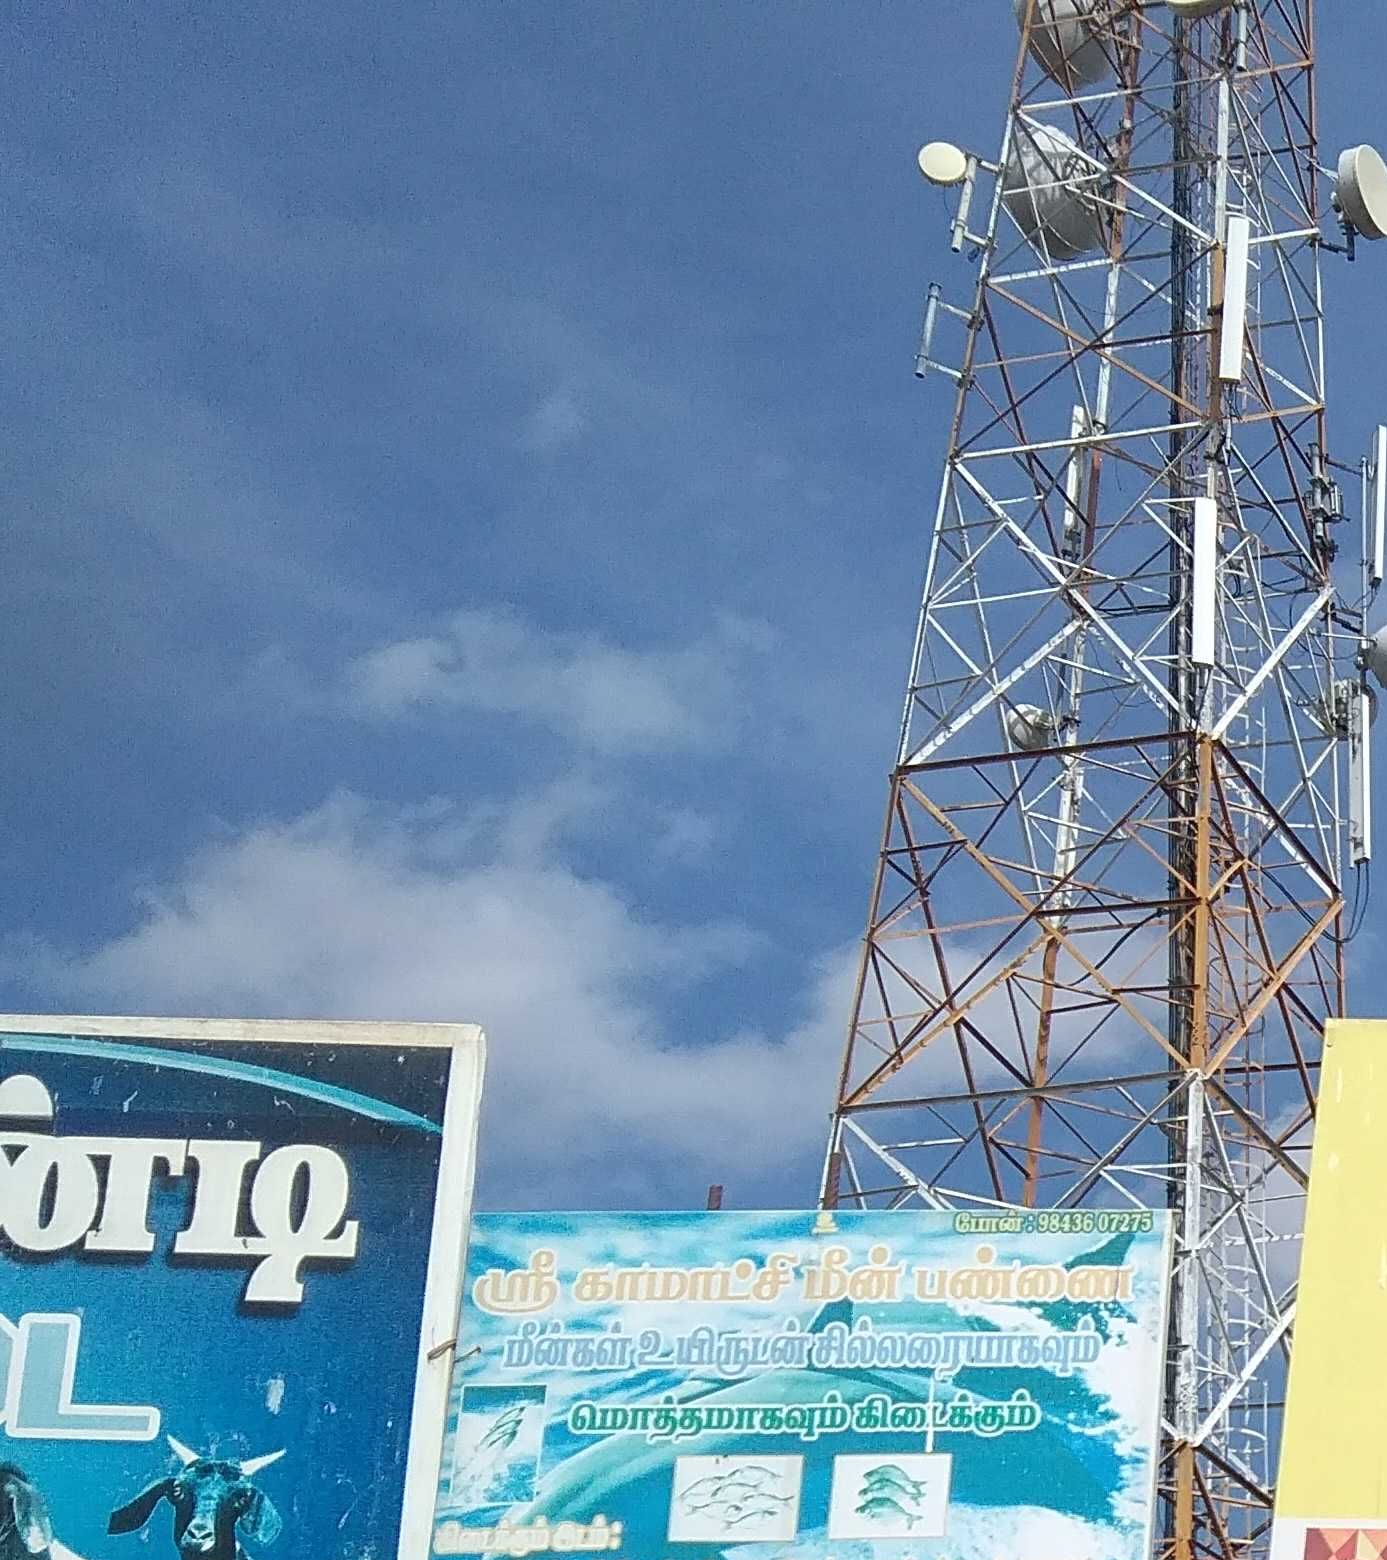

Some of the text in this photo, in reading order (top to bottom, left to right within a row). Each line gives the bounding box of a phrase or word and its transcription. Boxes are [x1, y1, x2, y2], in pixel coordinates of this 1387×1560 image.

[954, 1211, 1024, 1234] போன்
[1037, 1212, 1093, 1233] 98436
[1097, 1211, 1153, 1233] 07275
[574, 1253, 798, 1302] காமாட்சி
[803, 1246, 902, 1302] மீன்
[914, 1245, 1134, 1302] பண்ணை
[504, 1321, 632, 1370] மீன்கள்
[0, 1312, 160, 1440] L
[571, 1390, 1040, 1440] மொத்தமாகவும் கிடைக்கும்
